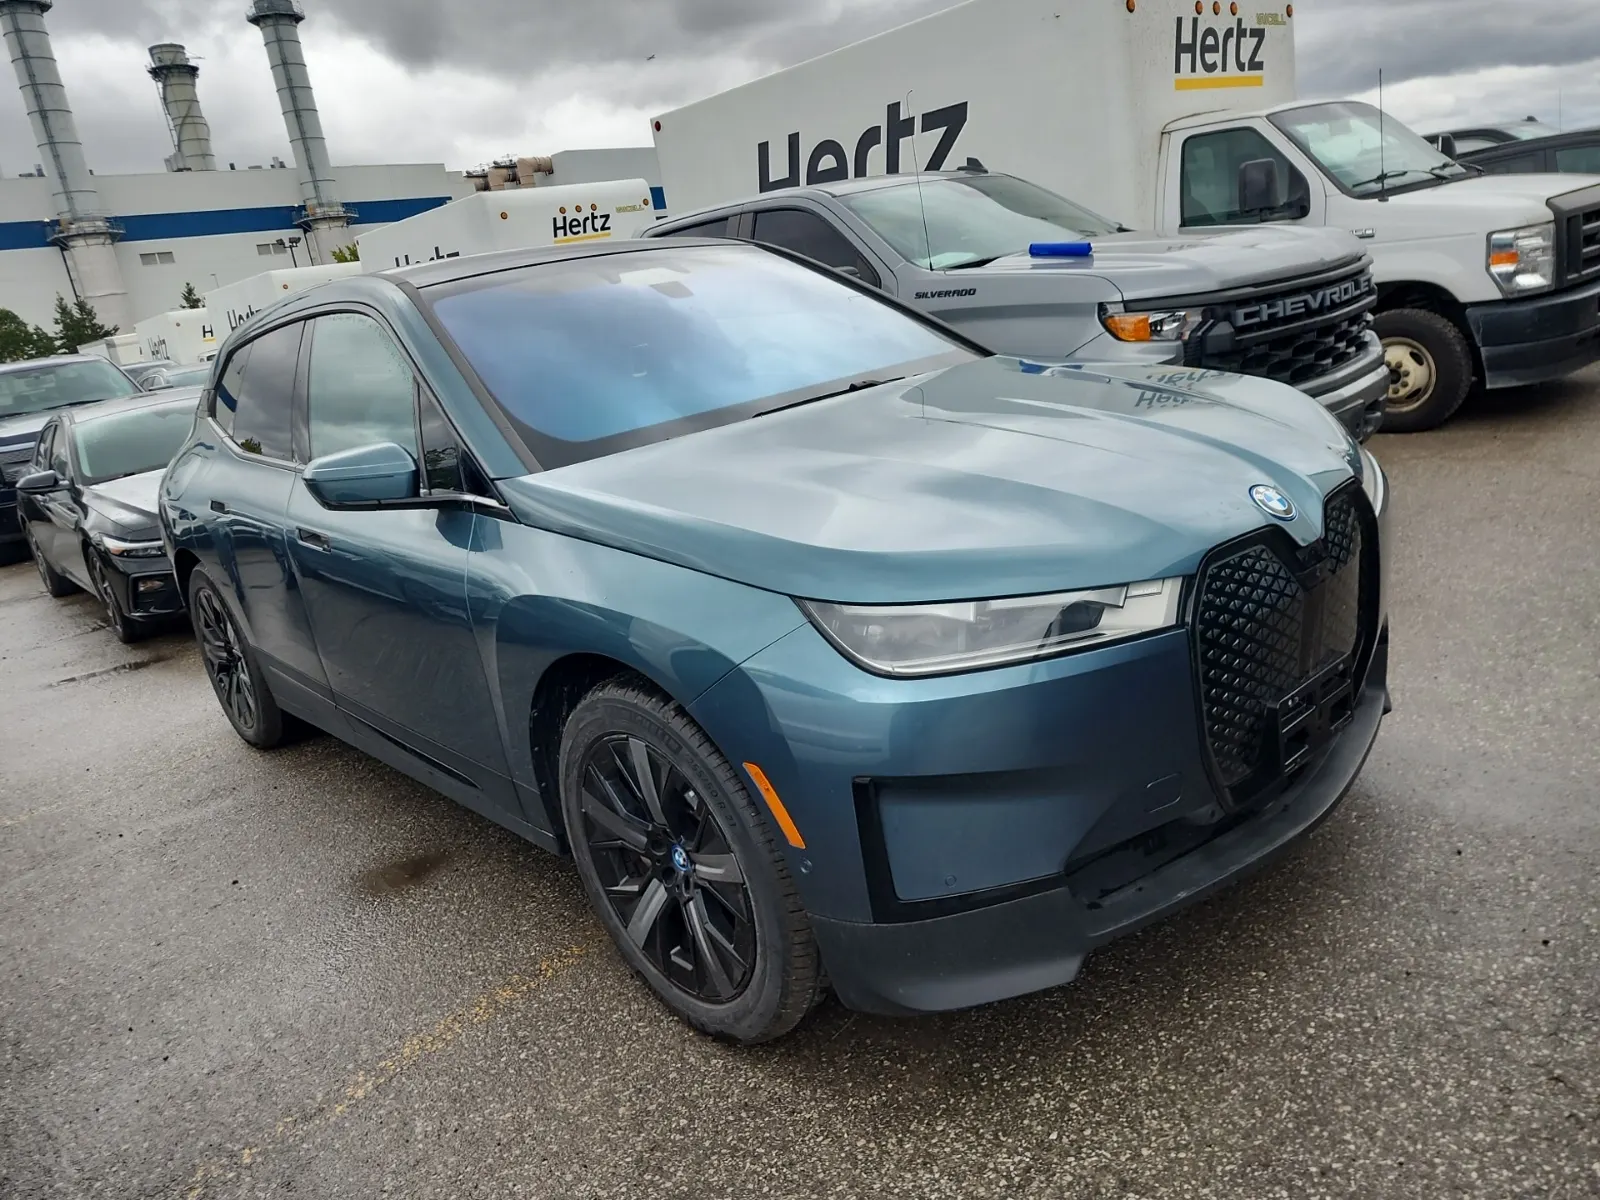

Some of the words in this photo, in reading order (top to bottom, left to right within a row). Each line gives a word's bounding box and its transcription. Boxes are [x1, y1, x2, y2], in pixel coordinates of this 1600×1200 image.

[1174, 16, 1266, 73] Hertz
[757, 101, 968, 194] Hertz
[552, 211, 611, 238] Hertz
[914, 288, 977, 300] SILVERADO
[1235, 273, 1373, 326] CHEVROLE
